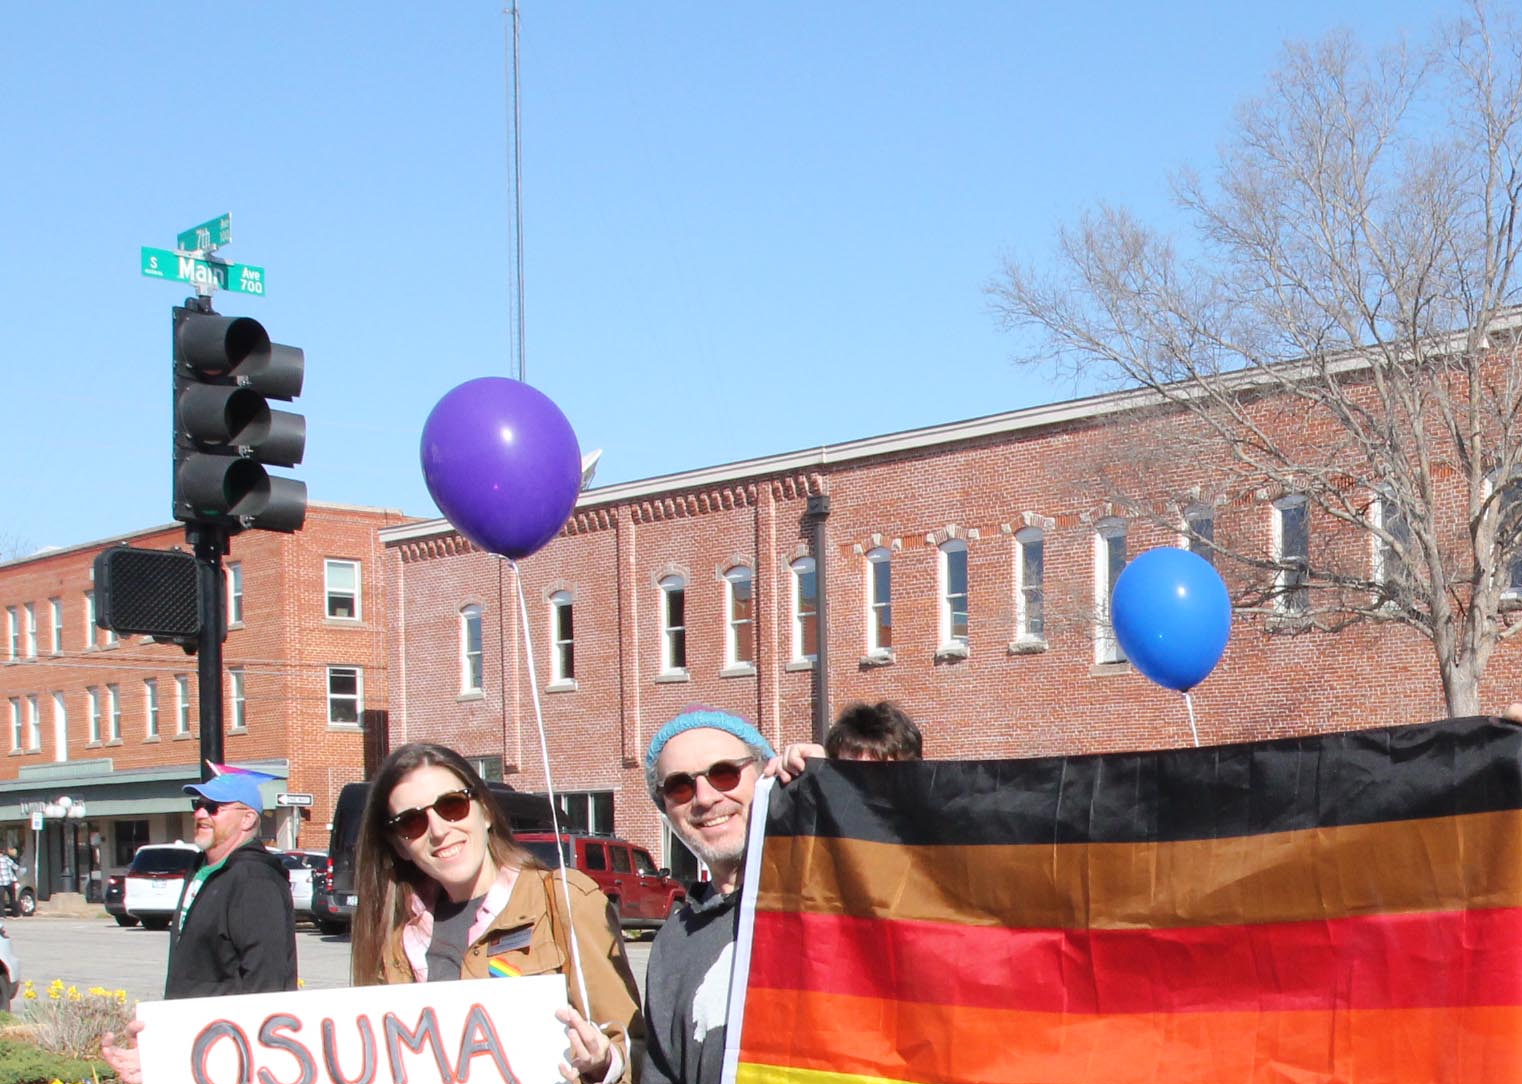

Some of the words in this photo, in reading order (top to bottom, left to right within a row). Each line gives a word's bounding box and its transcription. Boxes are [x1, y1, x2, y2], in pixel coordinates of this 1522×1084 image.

[150, 257, 158, 269] S
[179, 257, 224, 287] Main
[242, 268, 260, 281] Ave
[240, 279, 262, 294] 700
